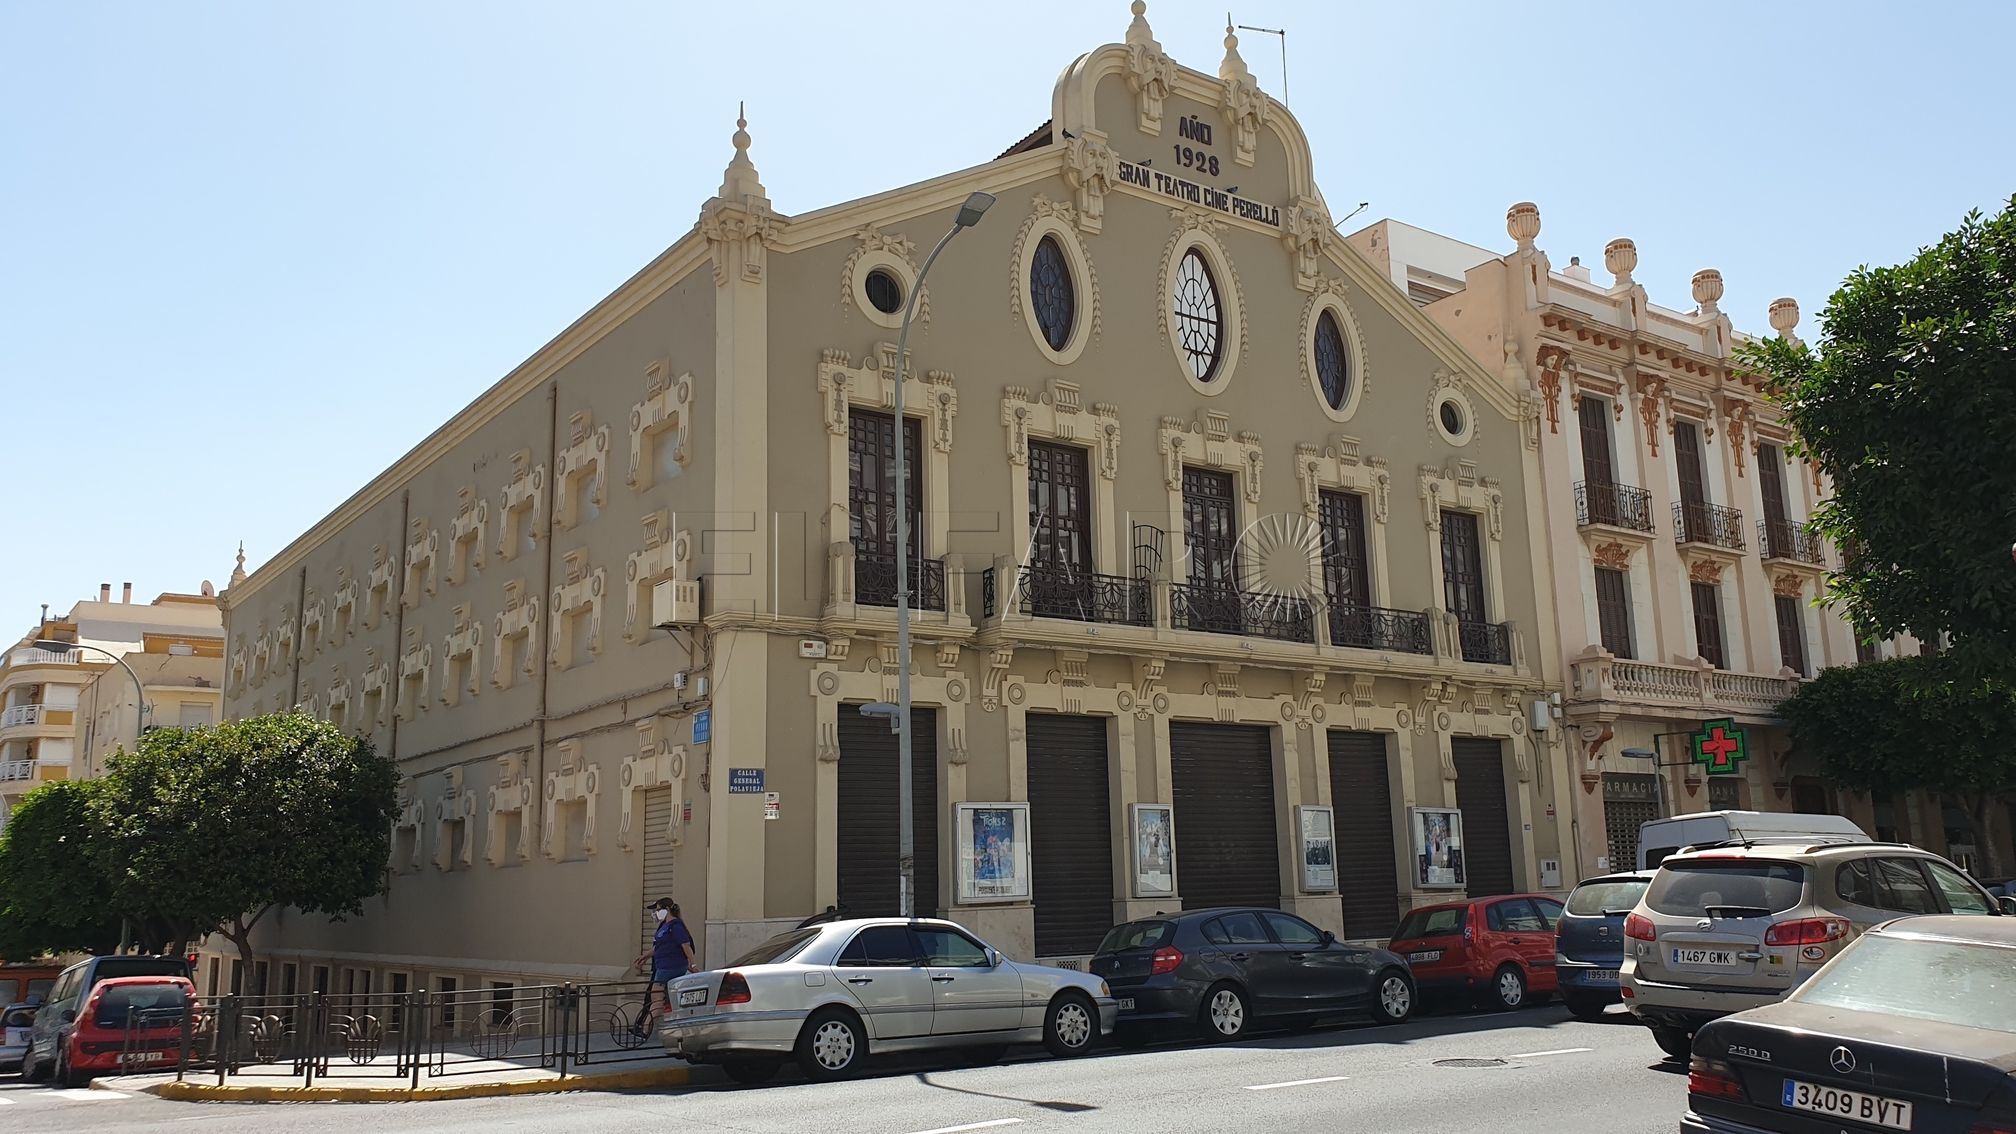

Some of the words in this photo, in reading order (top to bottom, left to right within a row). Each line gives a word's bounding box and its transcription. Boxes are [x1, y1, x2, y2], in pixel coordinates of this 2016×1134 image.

[1179, 115, 1212, 146] AÑO
[1173, 144, 1220, 177] 1928
[1118, 161, 1150, 188] GRAN
[1154, 172, 1200, 204] TEATRO
[1681, 951, 1706, 962] 1467
[1709, 952, 1730, 964] GWK
[1587, 970, 1606, 979] 1953
[1728, 1044, 1758, 1057] 250
[1796, 1085, 1851, 1114] 3409
[1860, 1097, 1906, 1124] BVT
